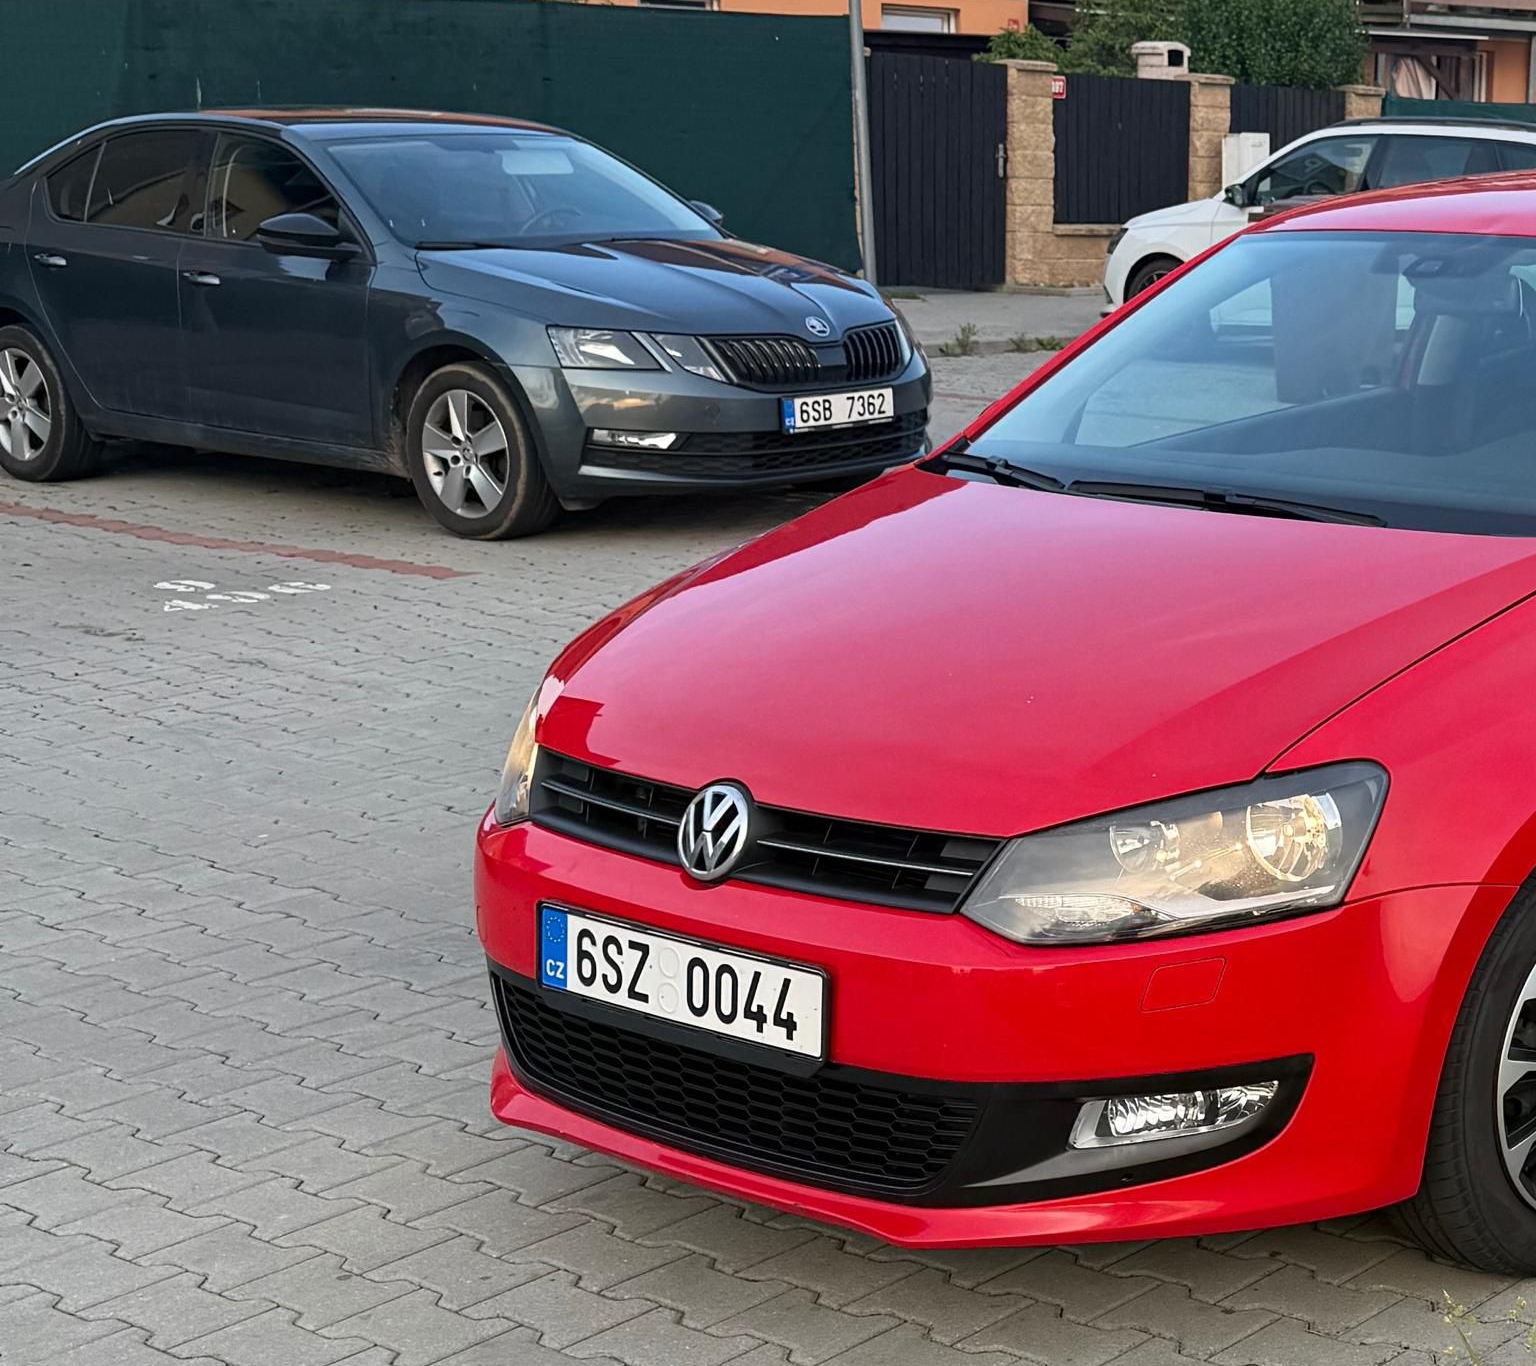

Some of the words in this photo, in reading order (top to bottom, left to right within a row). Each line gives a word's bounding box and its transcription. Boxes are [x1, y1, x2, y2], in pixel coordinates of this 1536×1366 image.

[800, 399, 832, 423] 6SB
[846, 393, 886, 420] 7362
[546, 959, 565, 979] CZ
[576, 928, 650, 1004] 6SZ
[686, 957, 798, 1042] 0044
